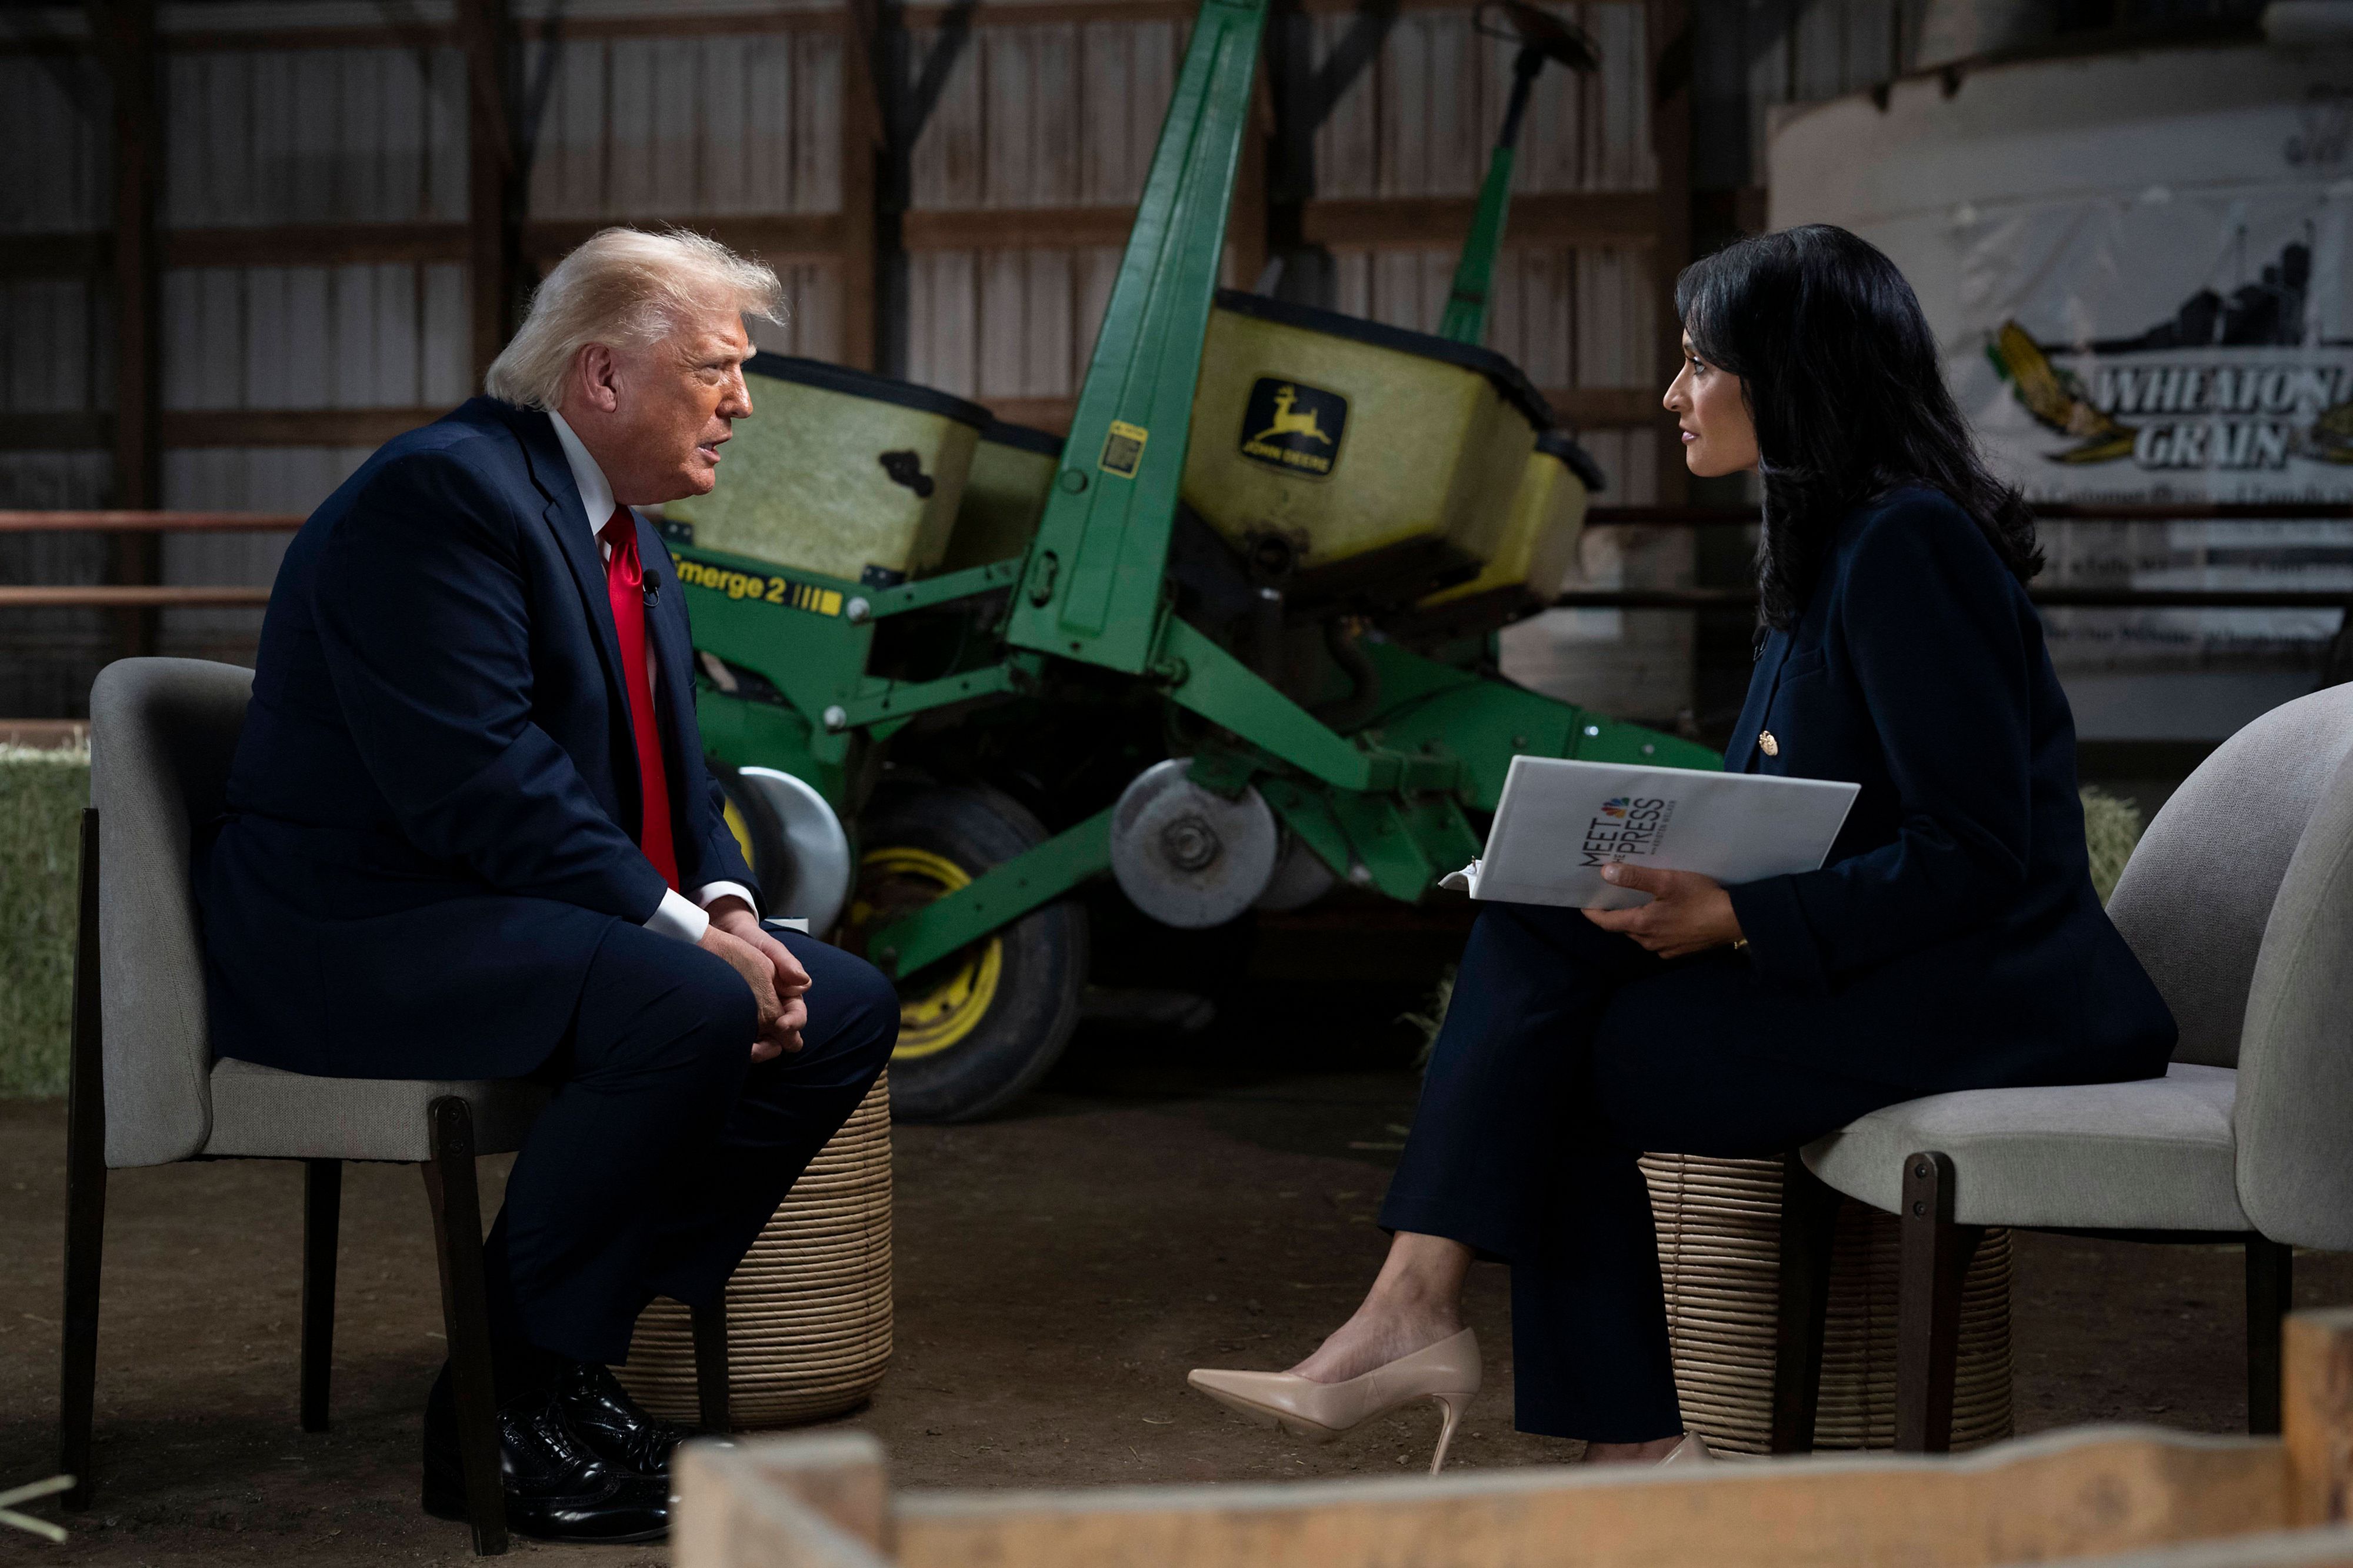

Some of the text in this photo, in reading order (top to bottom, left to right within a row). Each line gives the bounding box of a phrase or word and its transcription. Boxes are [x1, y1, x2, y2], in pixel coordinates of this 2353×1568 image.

[2134, 419, 2289, 471] GRAIN
[765, 577, 786, 603] 2
[1579, 817, 1621, 867] MEET
[1616, 798, 1665, 855] PRESS
[1611, 853, 1626, 863] HE
